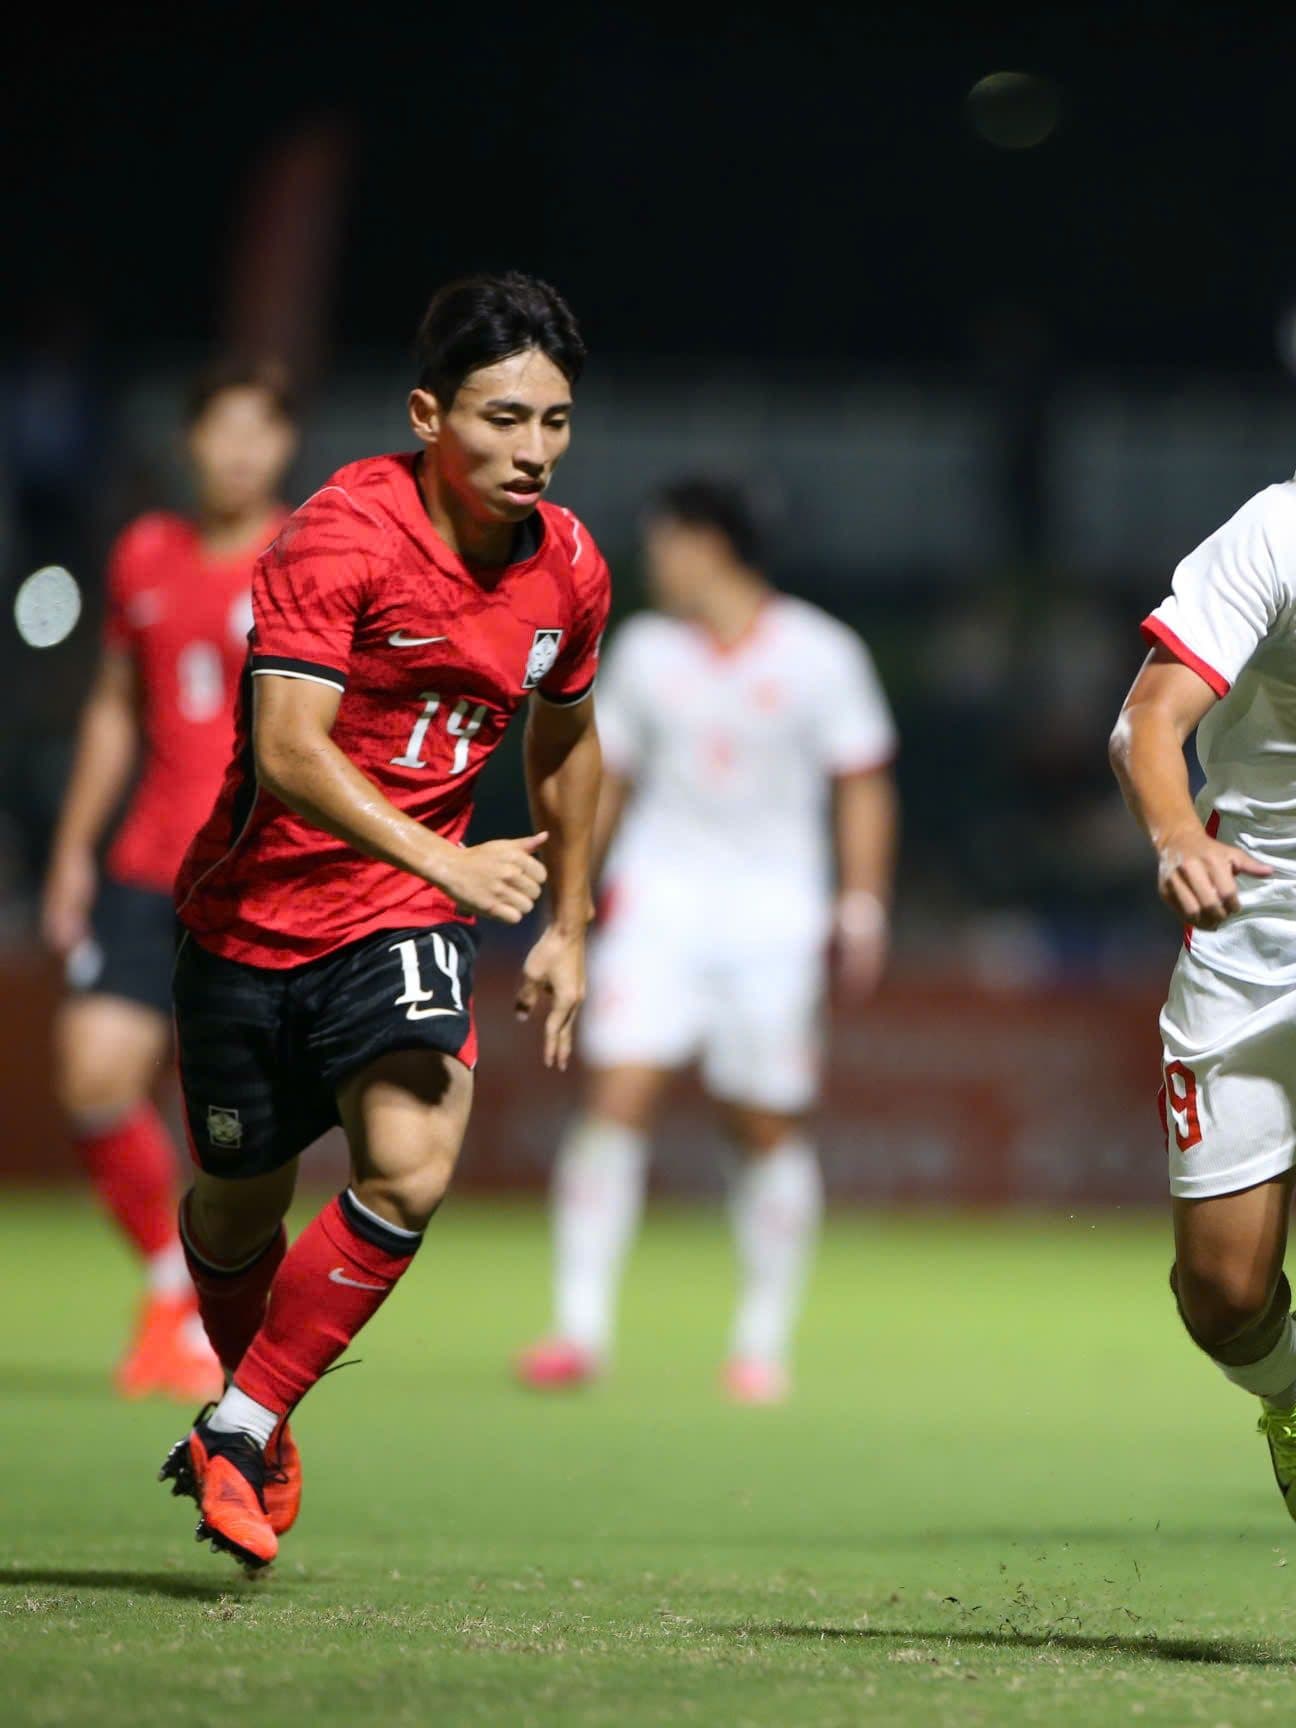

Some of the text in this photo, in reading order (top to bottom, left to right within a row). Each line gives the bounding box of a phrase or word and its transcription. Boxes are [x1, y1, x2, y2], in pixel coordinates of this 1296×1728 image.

[389, 692, 488, 774] 14
[388, 932, 463, 1011] 14
[1165, 1059, 1203, 1152] 9
